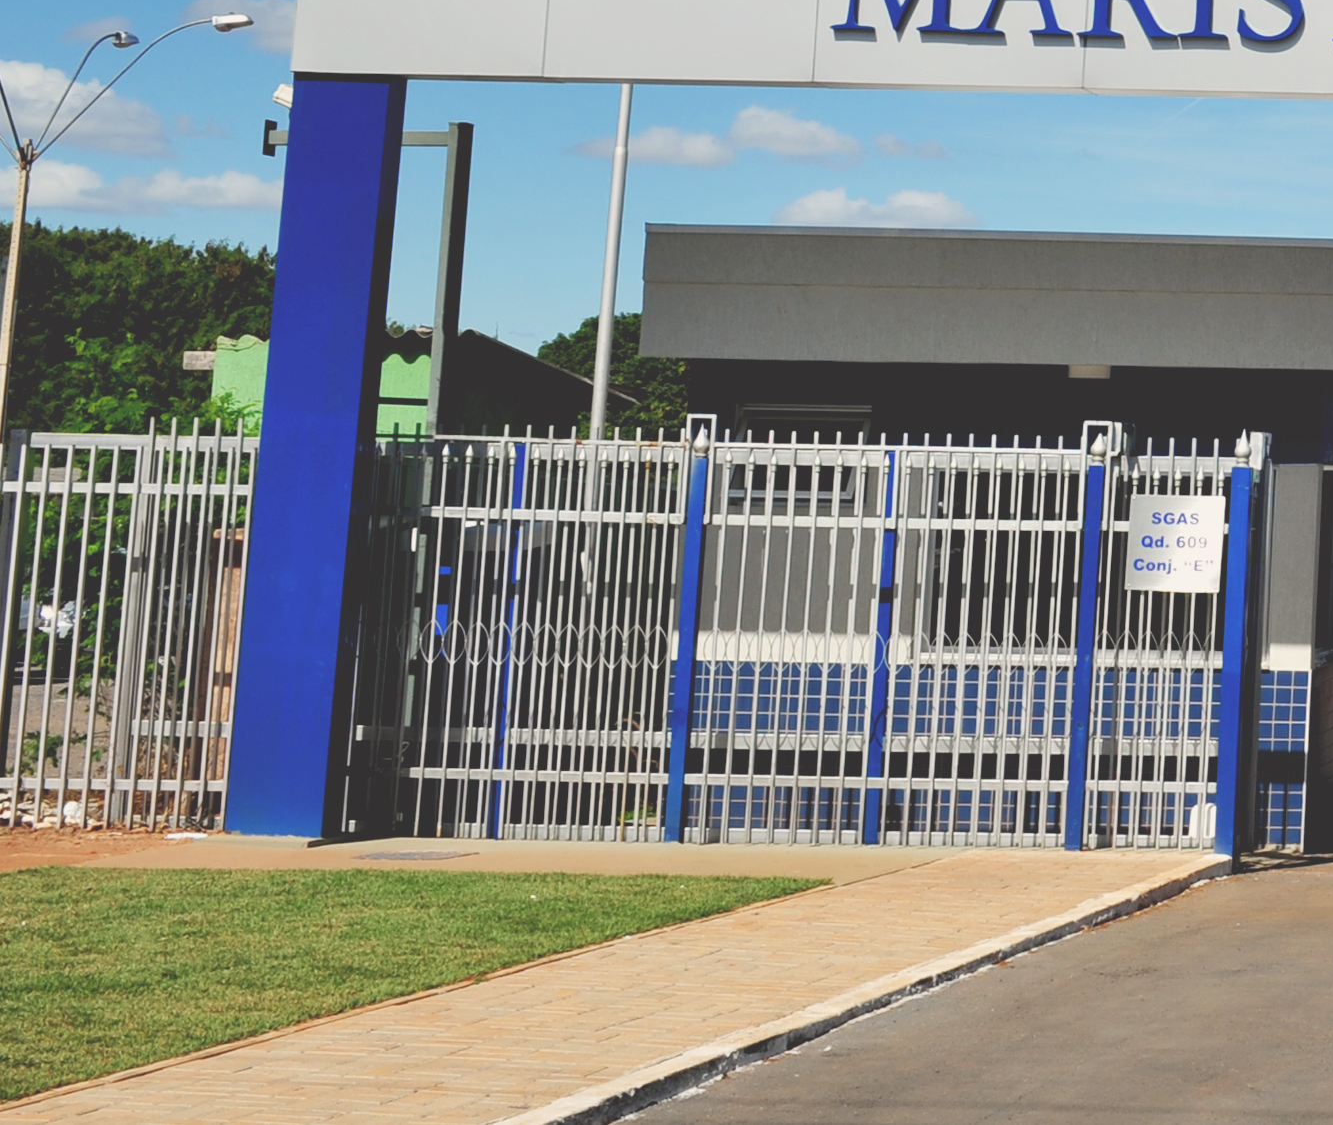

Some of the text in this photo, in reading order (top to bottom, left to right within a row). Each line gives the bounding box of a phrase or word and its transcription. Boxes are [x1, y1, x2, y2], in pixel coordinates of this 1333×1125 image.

[1151, 511, 1200, 525] SGAS
[1141, 535, 1207, 549] Qd. 609
[1133, 558, 1178, 575] Conj.
